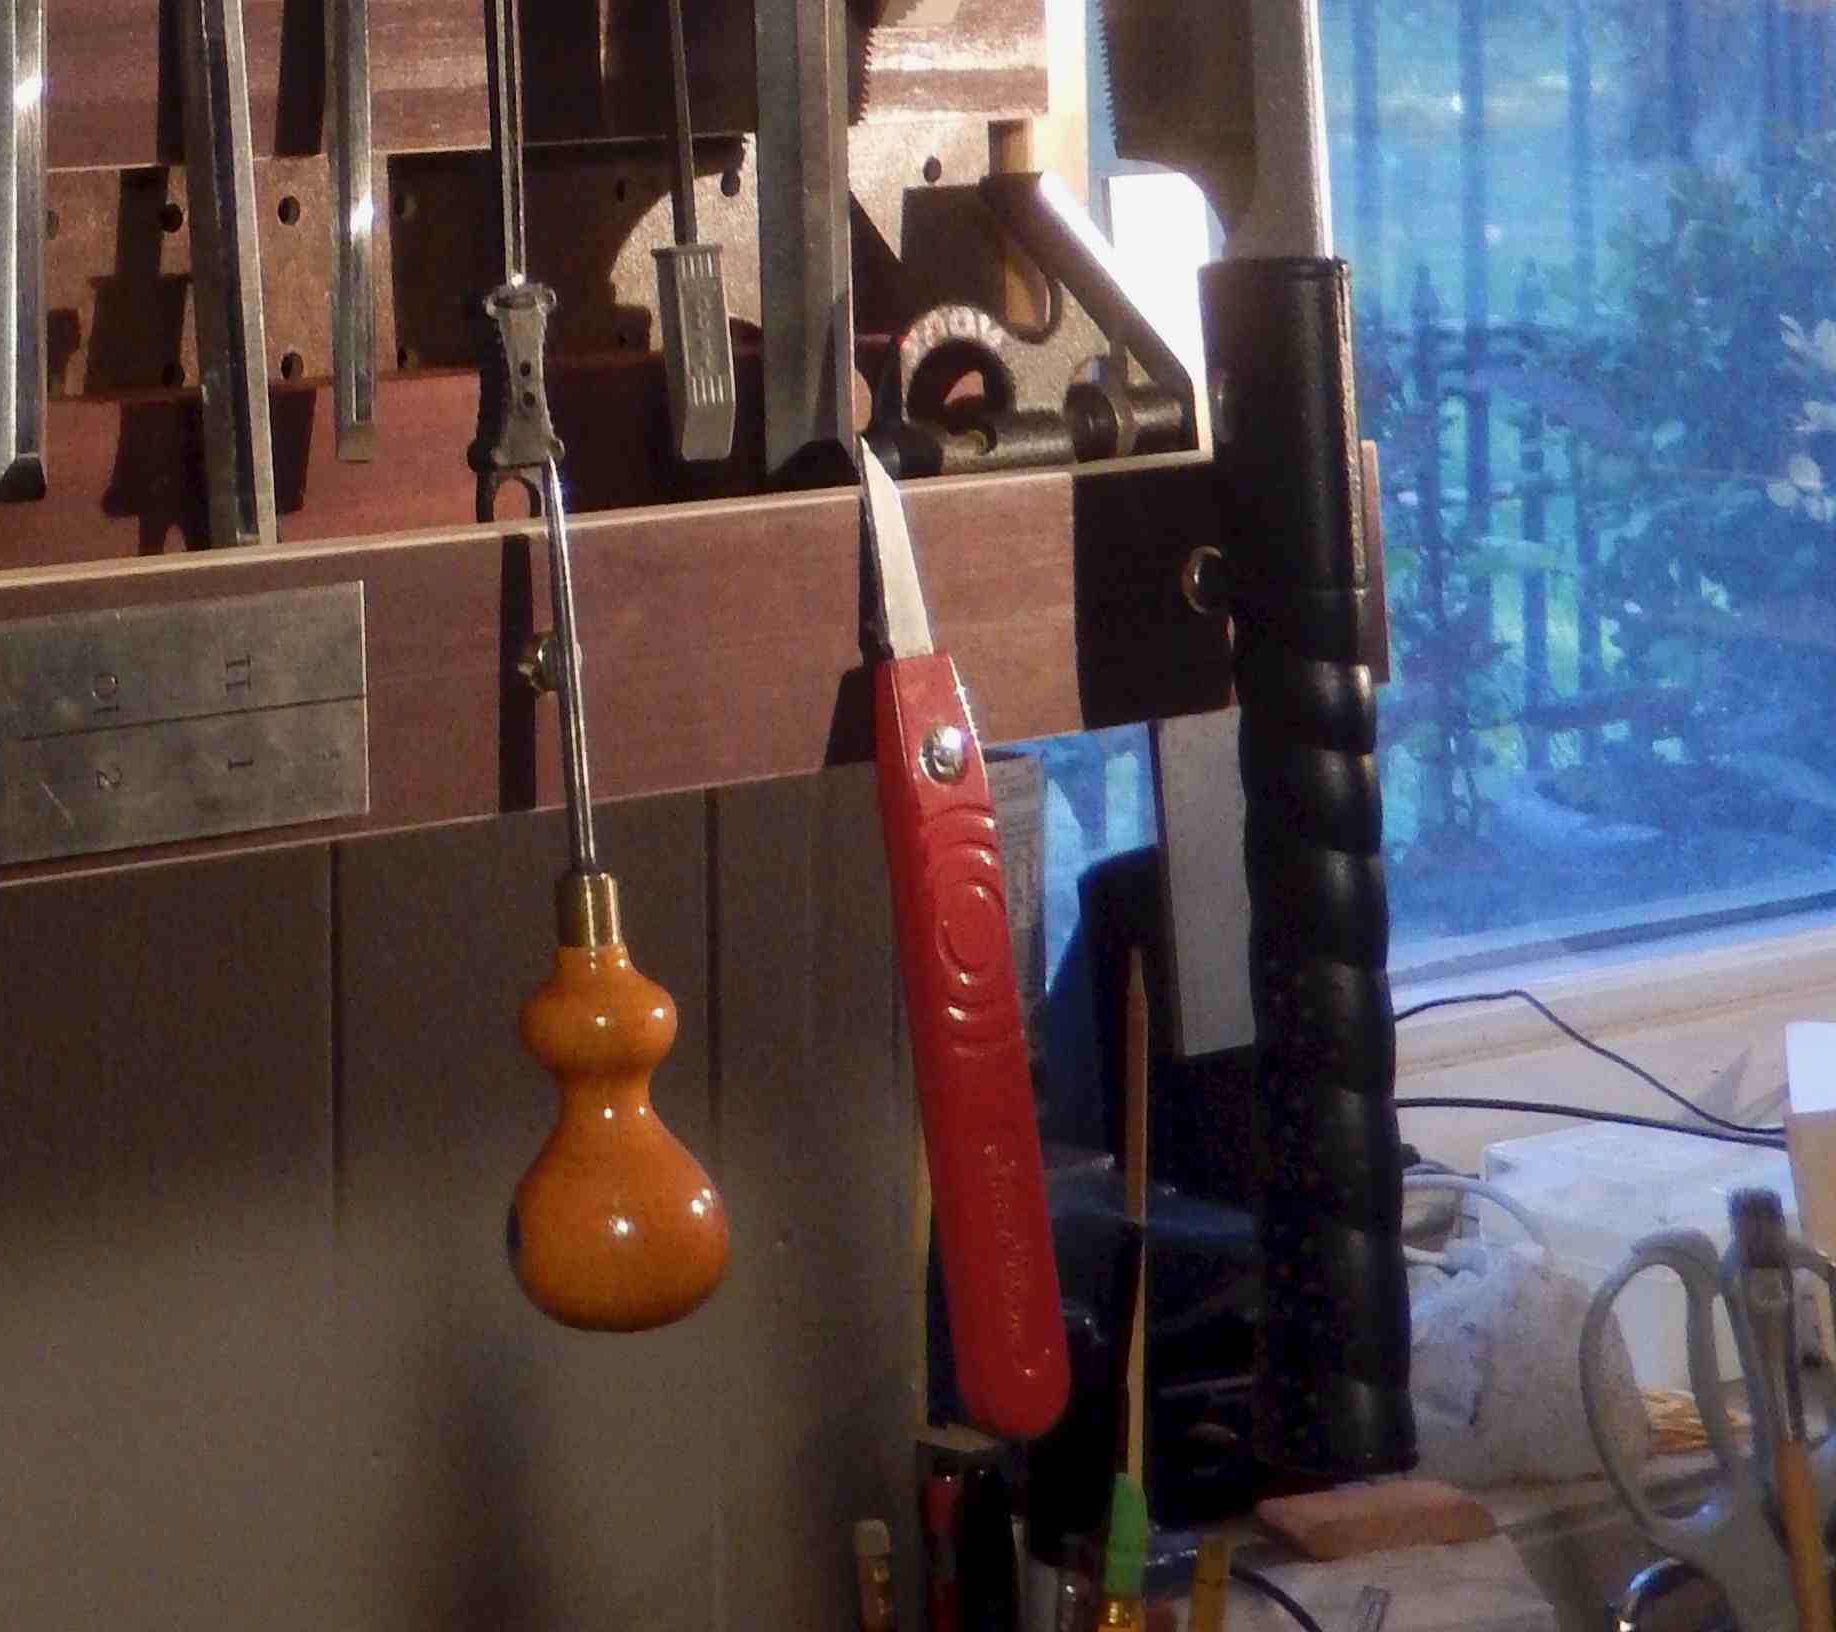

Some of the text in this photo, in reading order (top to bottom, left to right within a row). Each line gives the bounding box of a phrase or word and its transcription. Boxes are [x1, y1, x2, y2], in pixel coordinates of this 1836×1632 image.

[91, 672, 121, 716] 10
[225, 654, 252, 692] 11
[228, 759, 254, 772] 1
[96, 766, 124, 789] 2
